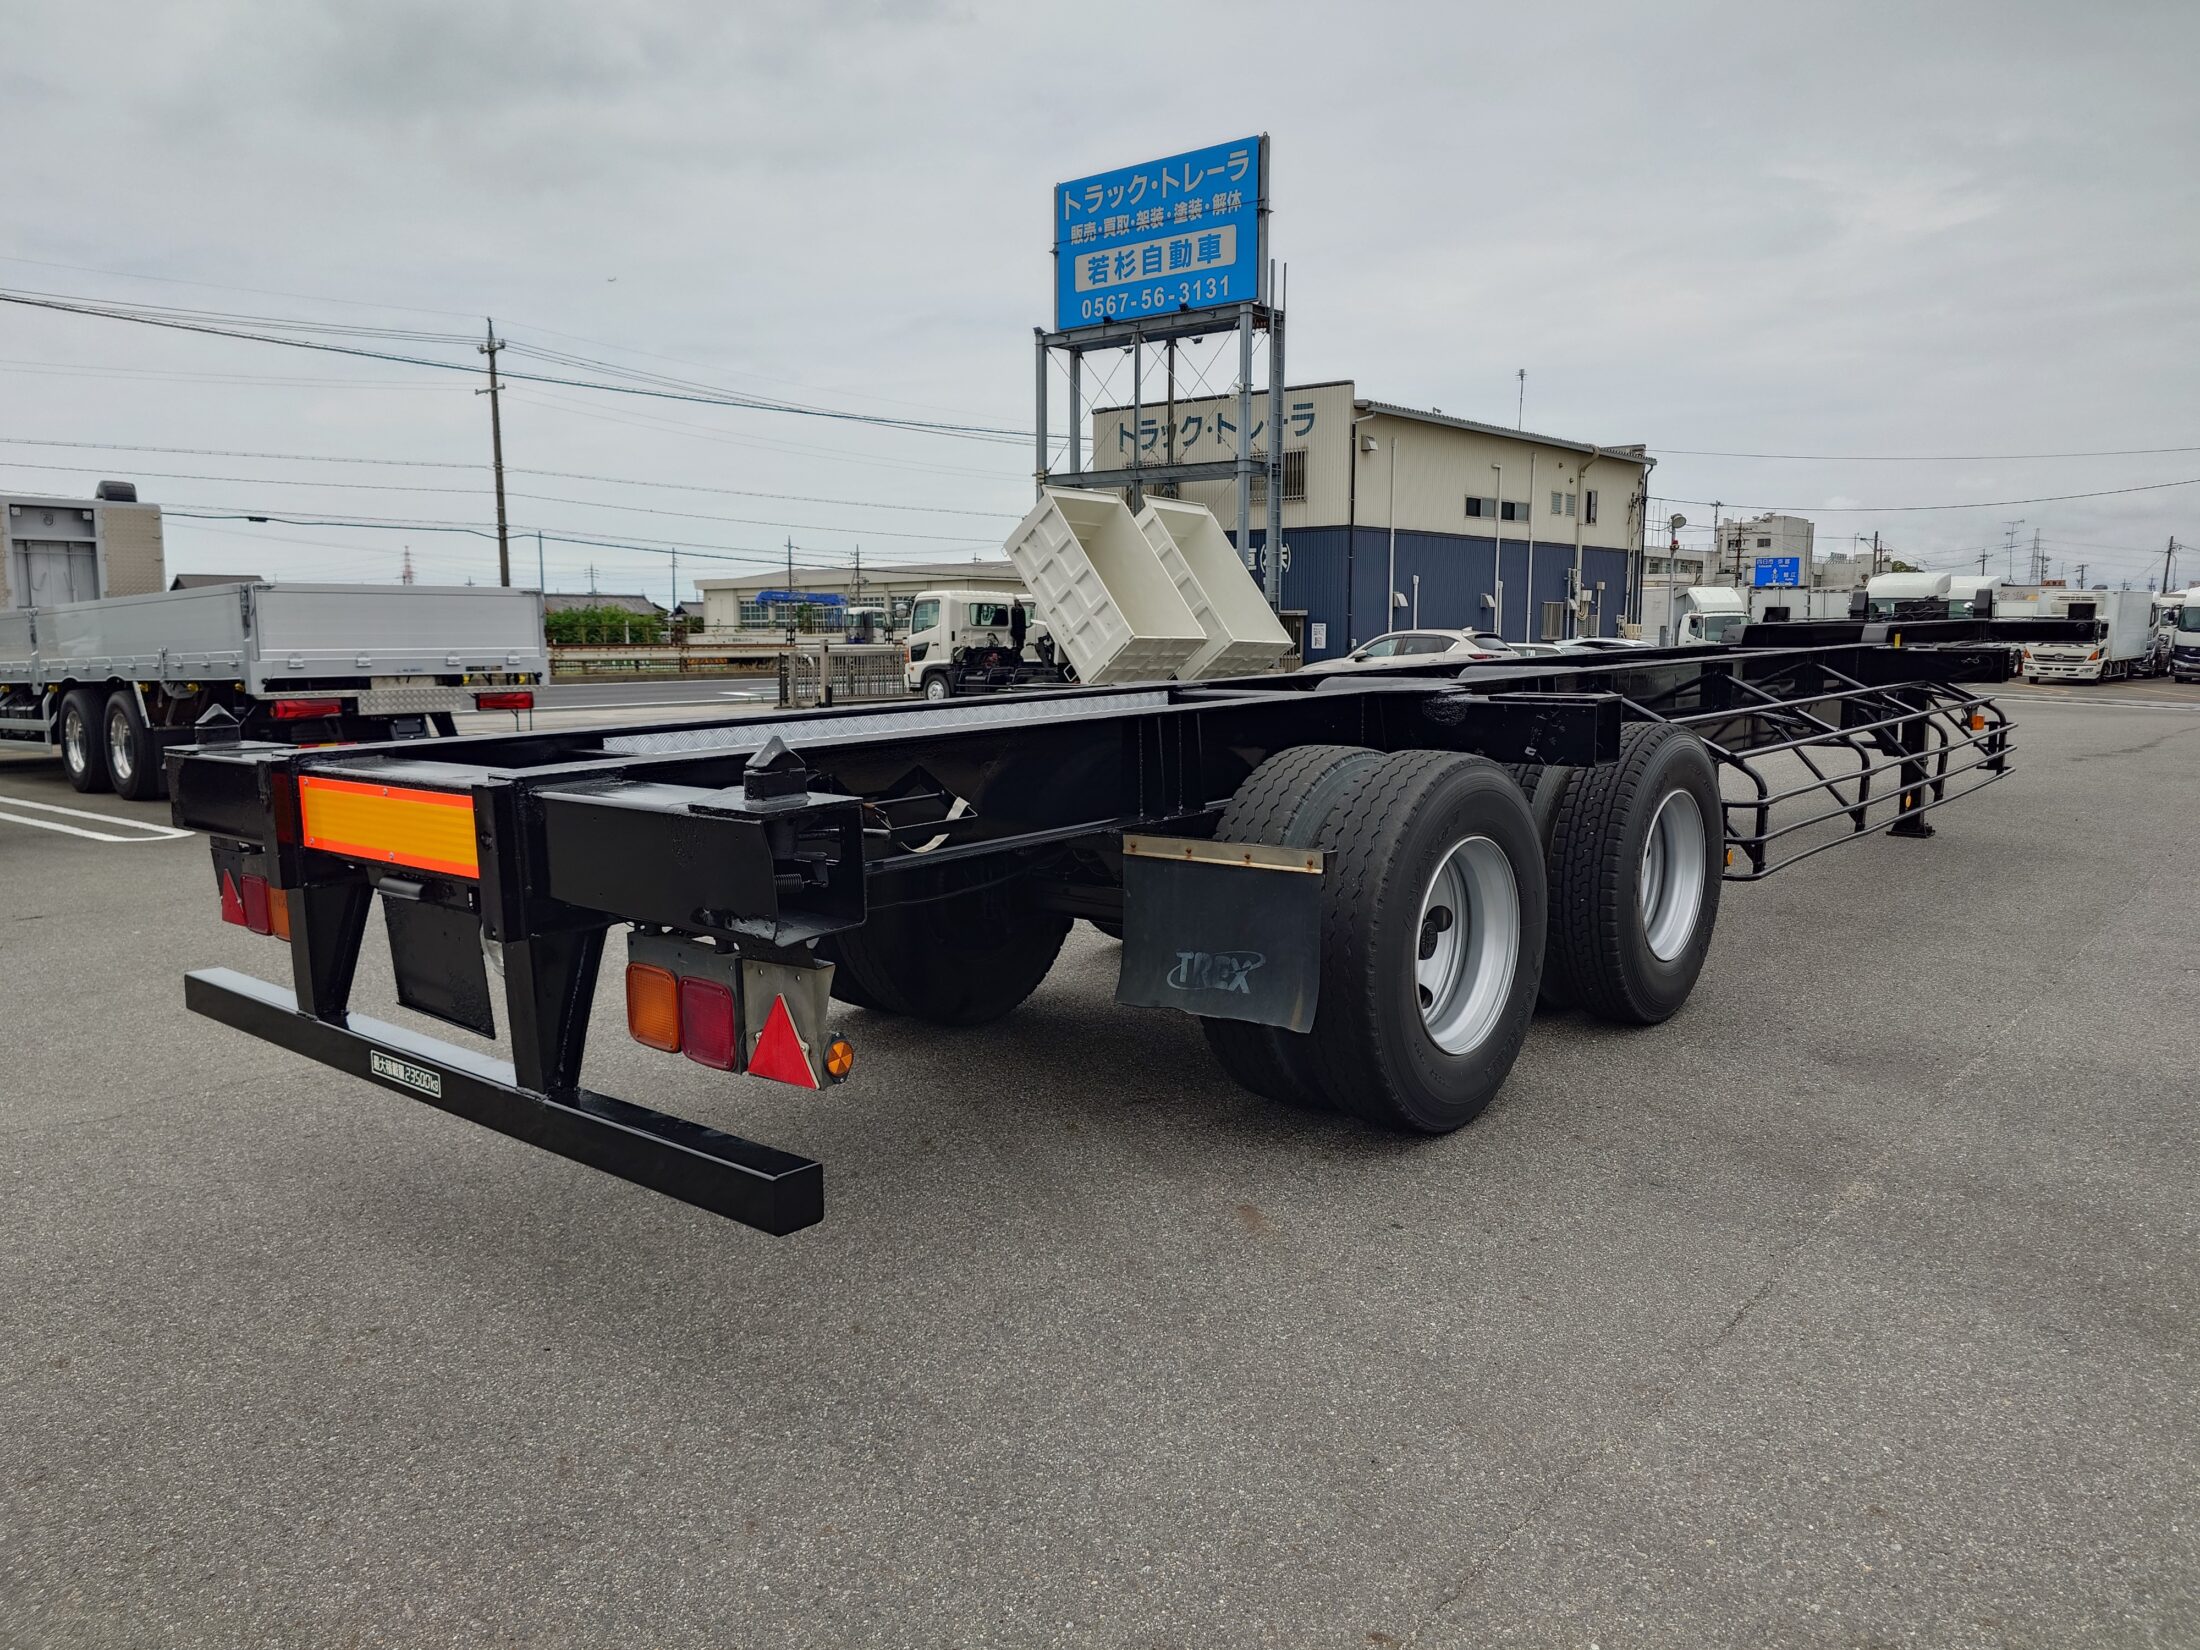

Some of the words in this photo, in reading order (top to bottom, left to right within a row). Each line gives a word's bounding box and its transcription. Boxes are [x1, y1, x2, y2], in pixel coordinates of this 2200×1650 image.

[1065, 149, 1250, 220] トラック・トレーラ
[1087, 233, 1222, 286] 若杉自動車
[1081, 275, 1230, 319] 0567-56-3131
[1119, 402, 1315, 452] トラック・トラ
